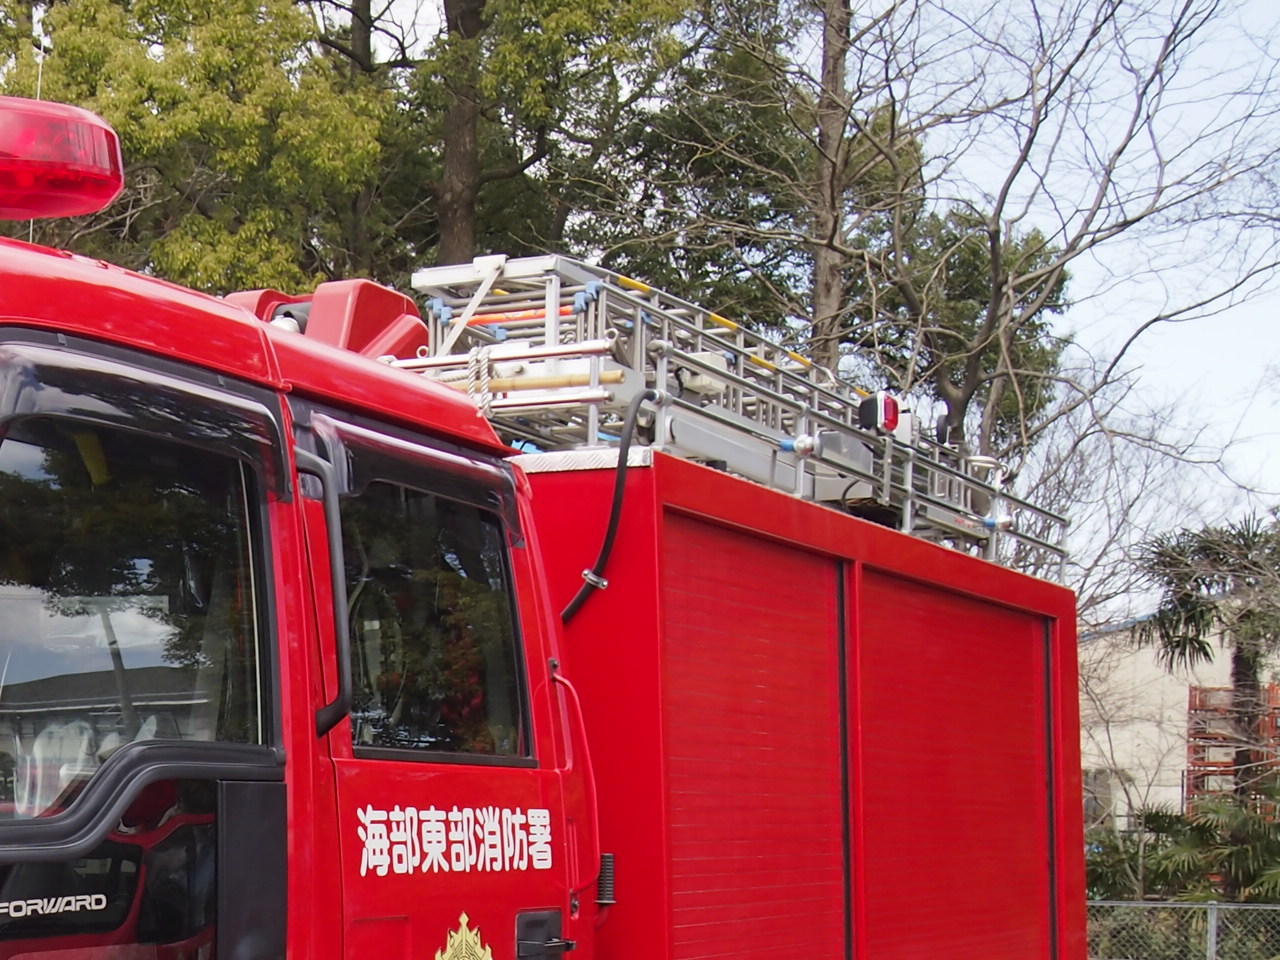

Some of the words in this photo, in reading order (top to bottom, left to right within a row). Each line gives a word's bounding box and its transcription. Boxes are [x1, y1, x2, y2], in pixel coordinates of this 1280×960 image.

[356, 803, 553, 878] 海部東部消防署
